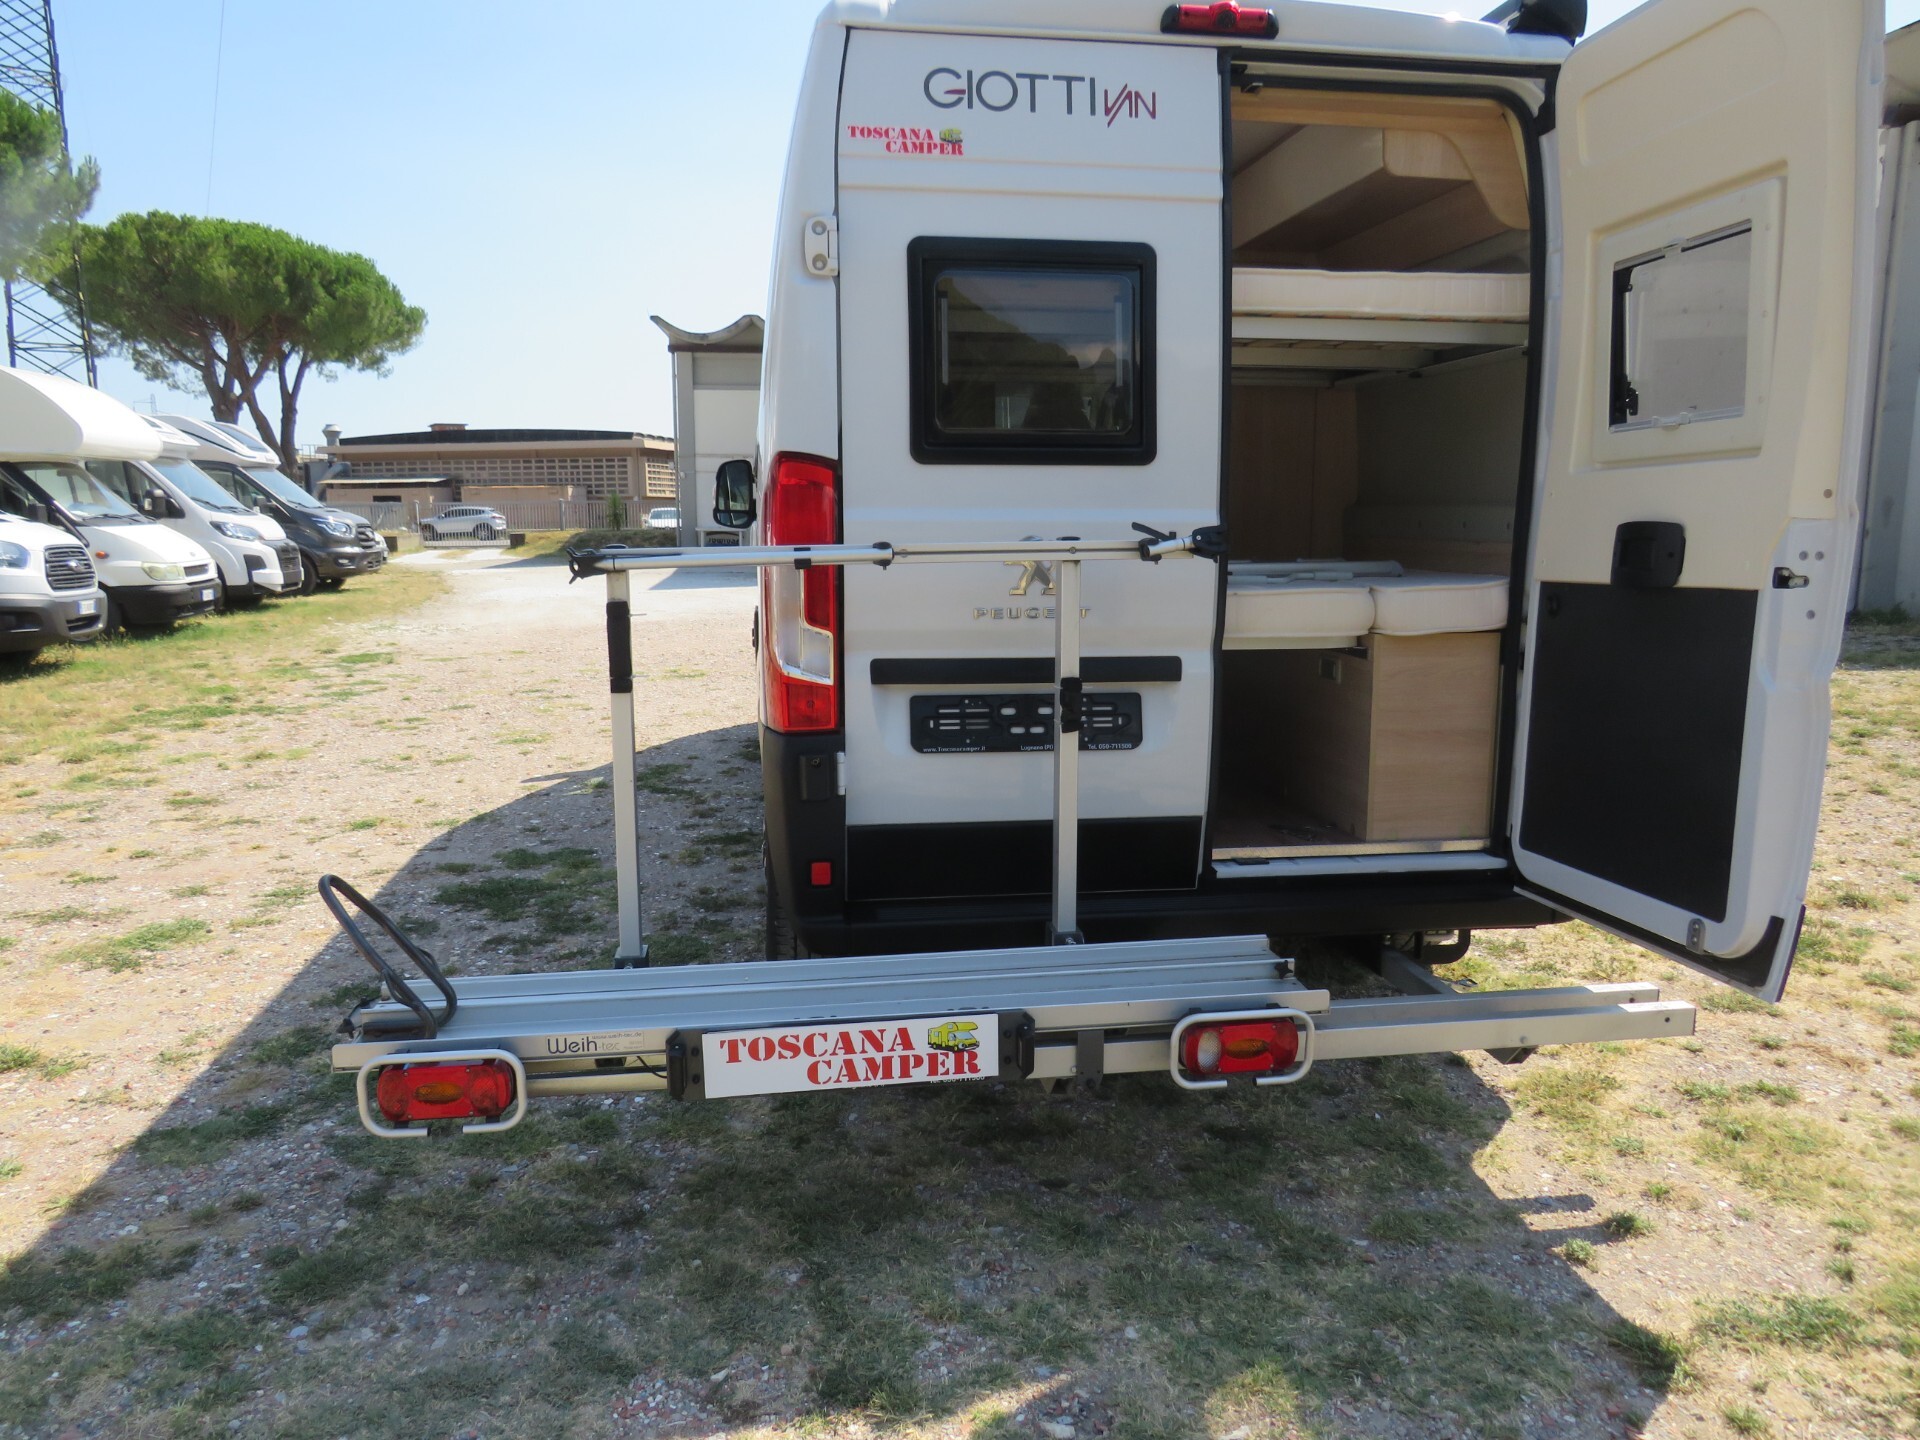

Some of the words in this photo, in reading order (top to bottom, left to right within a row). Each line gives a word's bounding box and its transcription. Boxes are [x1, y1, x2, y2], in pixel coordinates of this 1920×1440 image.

[848, 126, 934, 142] TOSCANA
[885, 140, 964, 156] CAMPER
[973, 607, 1091, 620] PEUGET
[719, 1027, 916, 1064] TOSCANA
[806, 1050, 982, 1085] CAMPER
